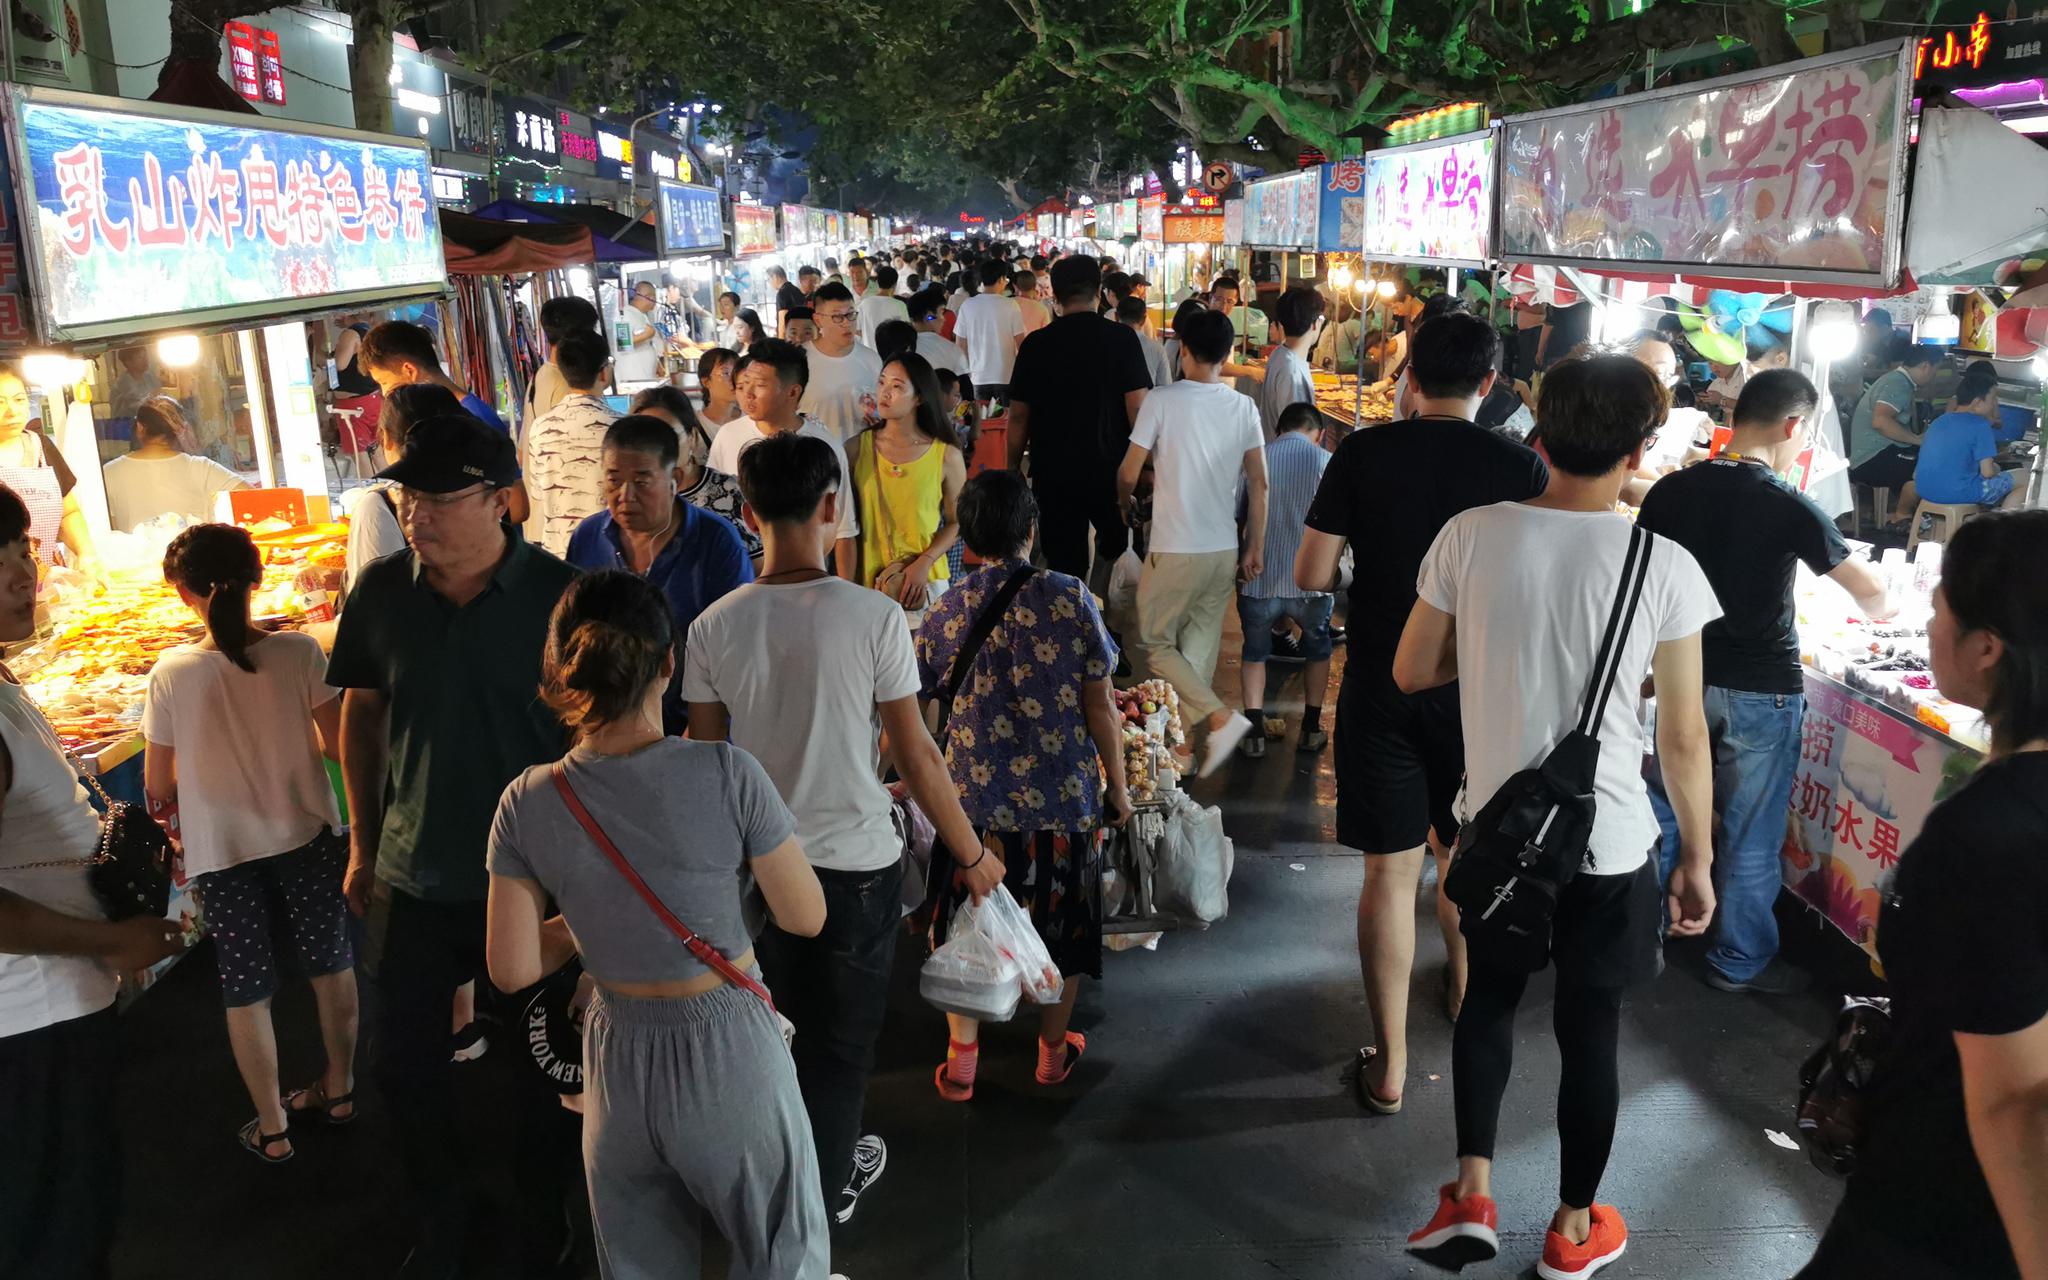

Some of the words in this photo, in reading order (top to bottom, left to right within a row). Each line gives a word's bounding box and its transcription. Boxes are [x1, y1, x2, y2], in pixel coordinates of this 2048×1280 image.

[1327, 160, 1364, 192] 烤
[1802, 713, 1836, 768] 捞
[1832, 696, 1881, 740] 爽口美味
[529, 1013, 555, 1070] YORK
